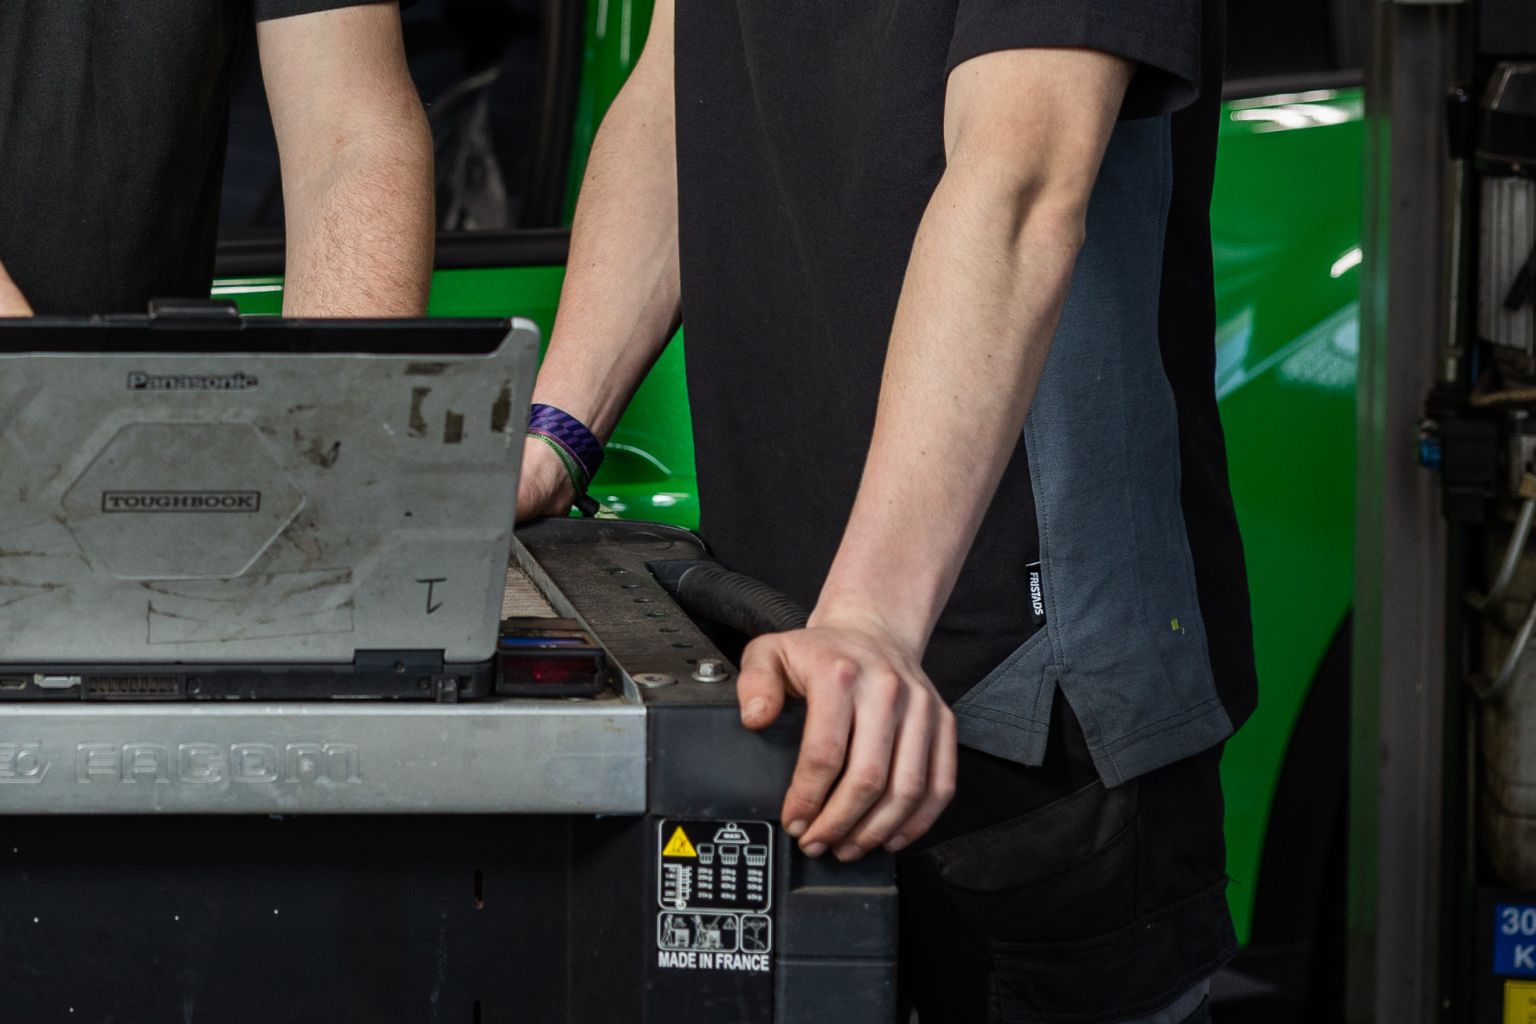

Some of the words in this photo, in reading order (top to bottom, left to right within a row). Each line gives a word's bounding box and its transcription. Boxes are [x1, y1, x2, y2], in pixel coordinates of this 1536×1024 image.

[127, 370, 259, 392] Panasonic
[108, 494, 255, 509] TOUGHBOOK
[1029, 571, 1044, 616] FRISTADS
[76, 741, 363, 784] FACOM
[658, 951, 697, 969] MADE
[699, 952, 714, 970] IN
[715, 953, 770, 972] FRANCE
